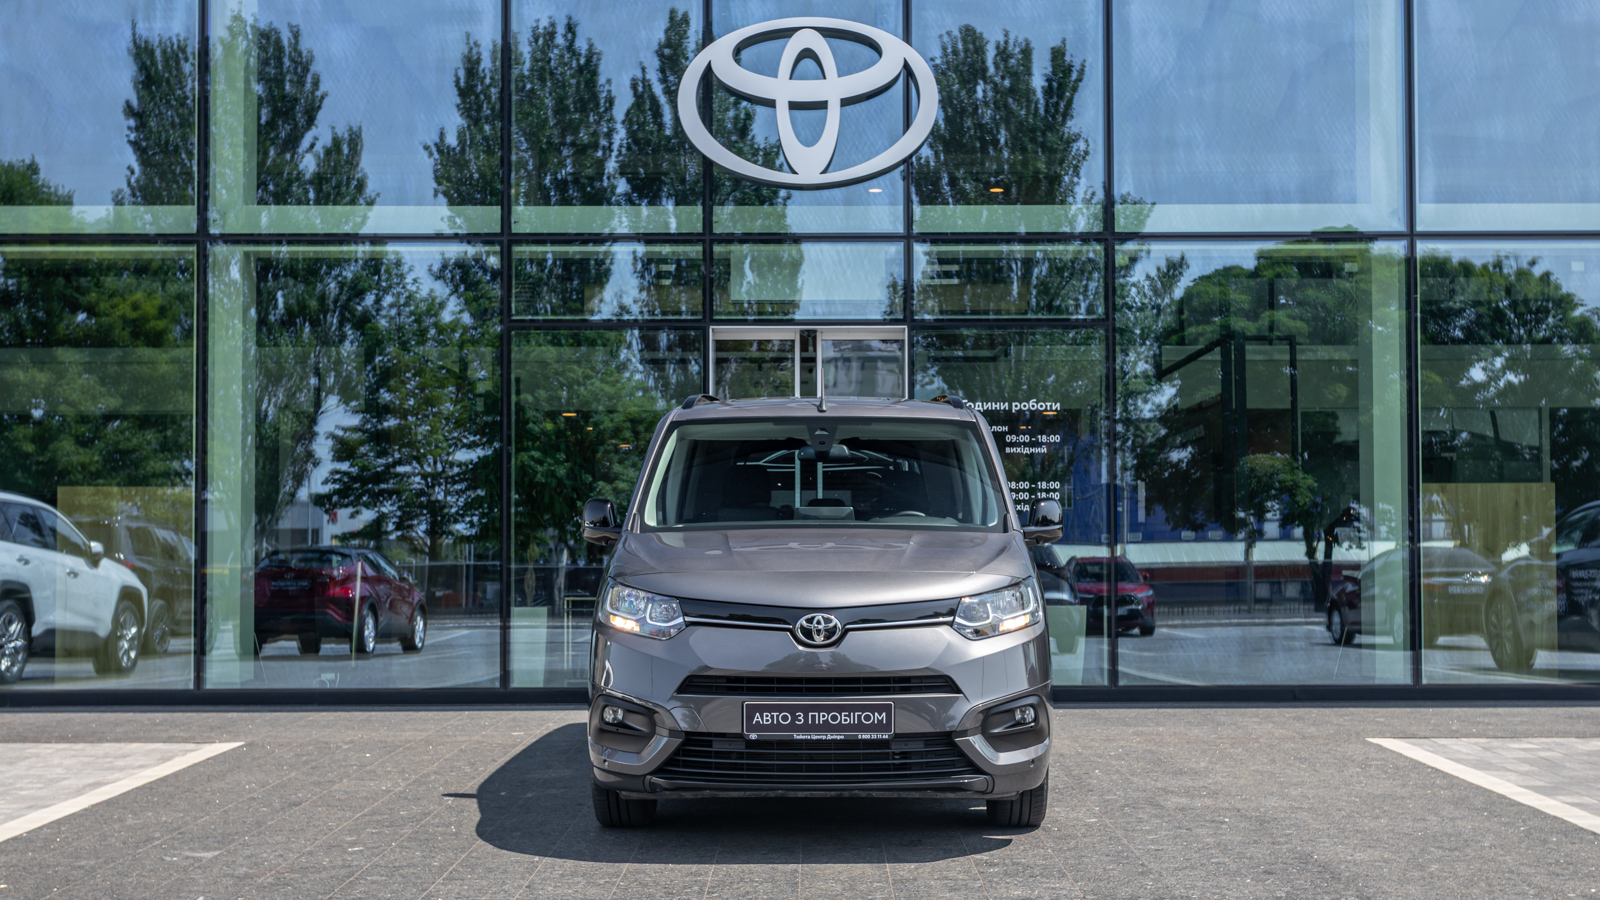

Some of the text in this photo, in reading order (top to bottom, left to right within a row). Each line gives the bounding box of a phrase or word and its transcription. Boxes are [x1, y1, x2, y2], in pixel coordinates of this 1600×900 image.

[1011, 399, 1061, 413] роботи
[1005, 434, 1030, 443] 09:00
[1037, 434, 1061, 443] 18:00
[1005, 445, 1047, 455] вихідний
[1037, 481, 1061, 489] 18:00
[1010, 492, 1030, 500] 9:00
[752, 712, 886, 725] АВТО З ПРОБІГОМ
